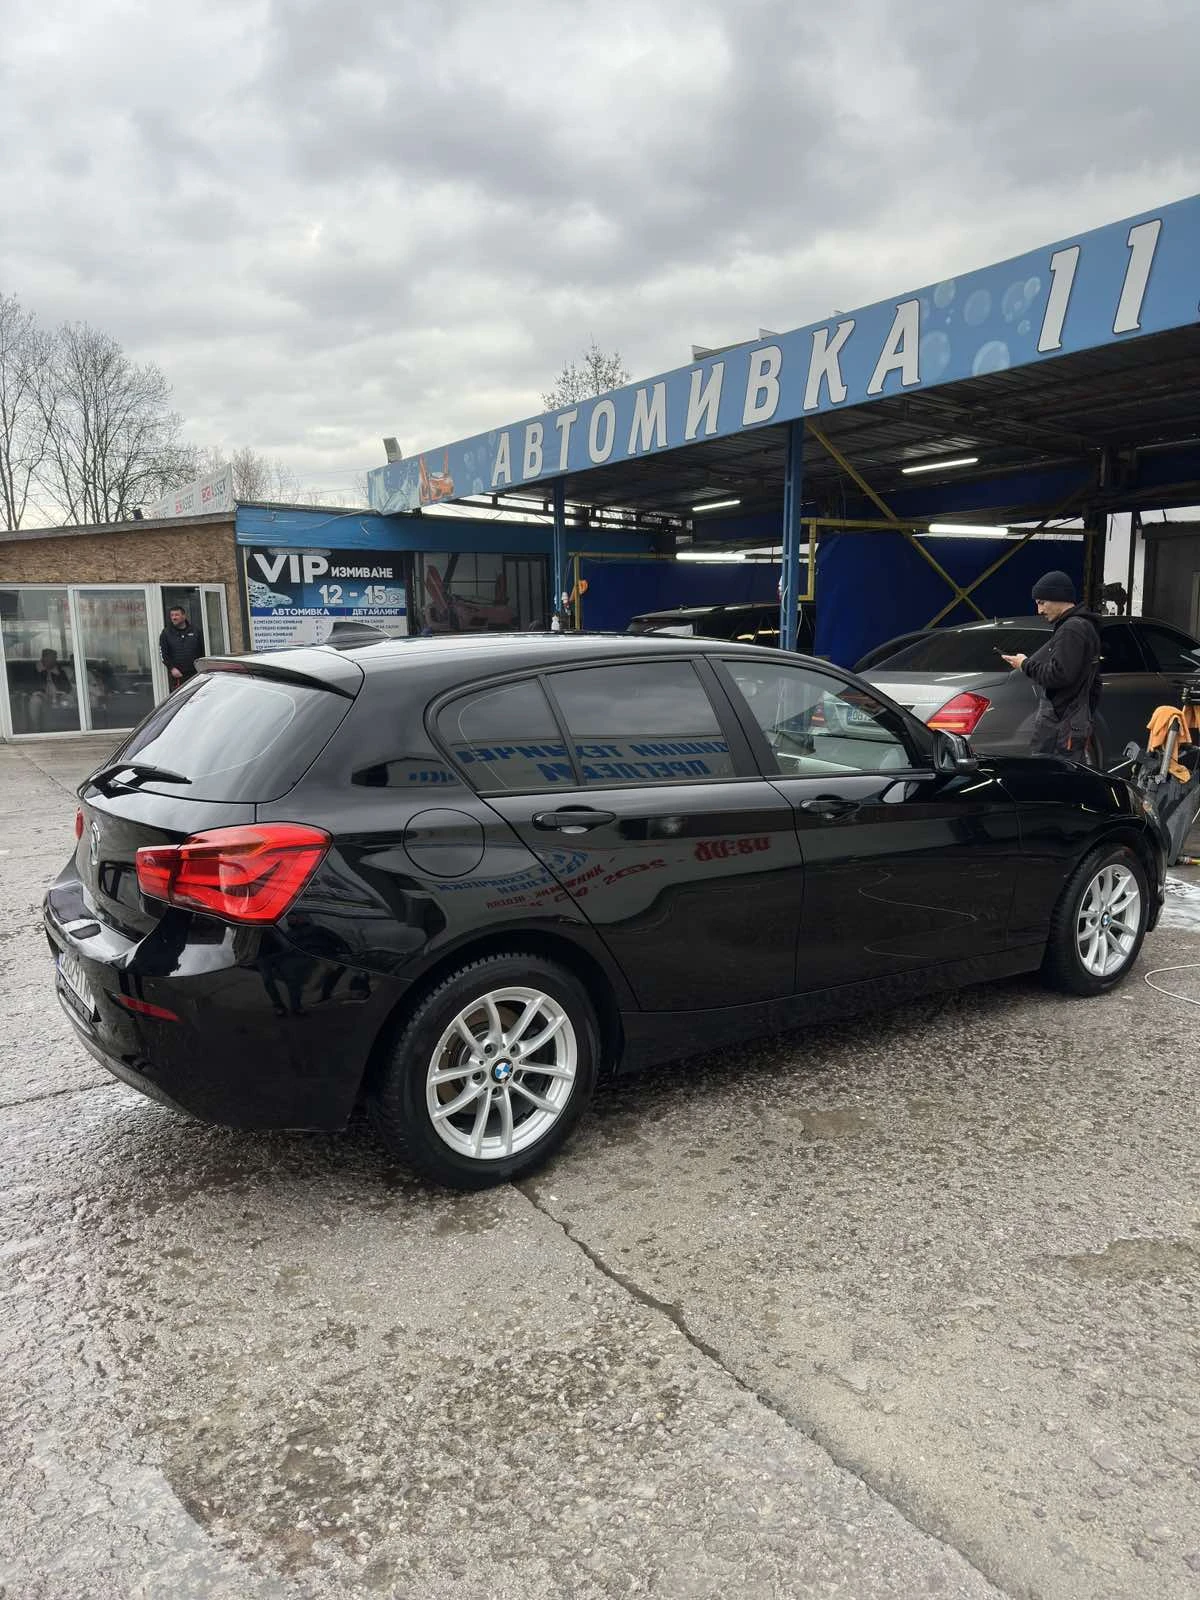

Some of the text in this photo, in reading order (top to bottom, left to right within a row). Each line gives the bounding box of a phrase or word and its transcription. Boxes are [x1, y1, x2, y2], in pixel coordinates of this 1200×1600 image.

[491, 299, 921, 487] АВТОМИВКА
[253, 553, 393, 584] VIP ИЗМИВАНЕ
[319, 584, 344, 604] 12
[271, 608, 330, 616] АВТОМИВКА
[352, 608, 400, 616] ДЕТАЙЛИНГ
